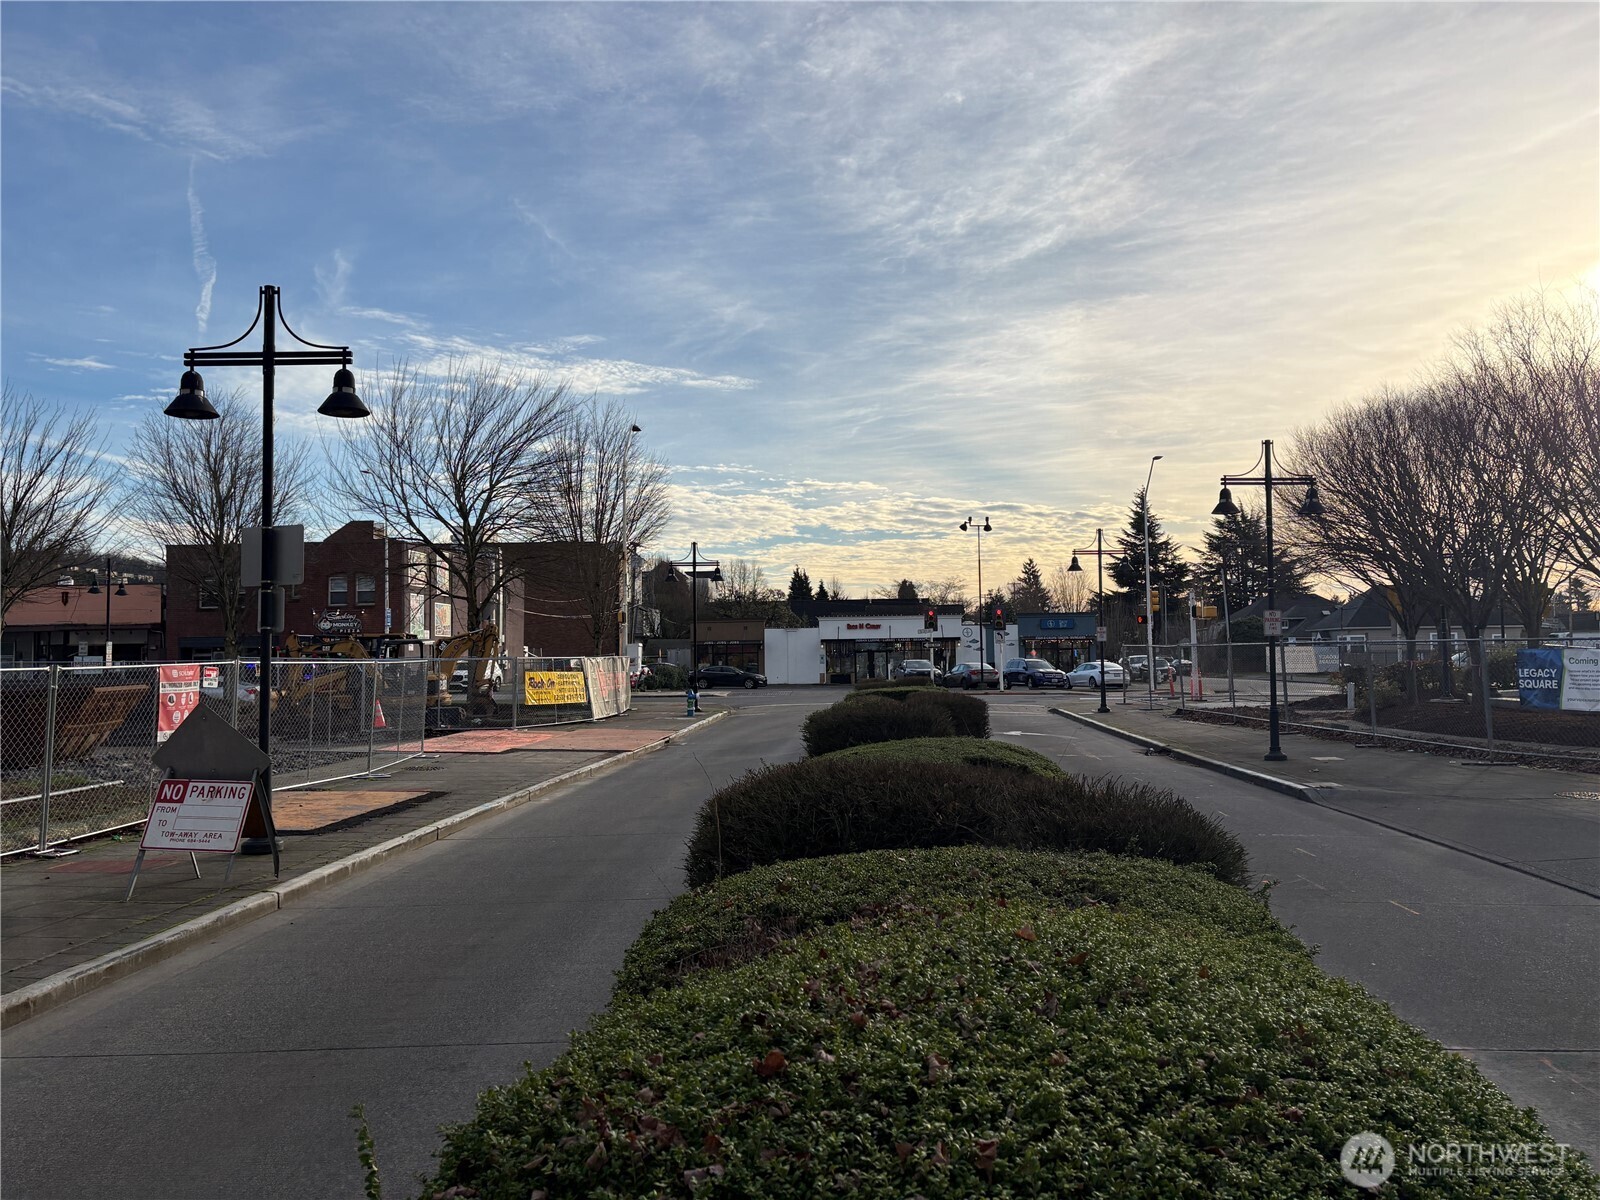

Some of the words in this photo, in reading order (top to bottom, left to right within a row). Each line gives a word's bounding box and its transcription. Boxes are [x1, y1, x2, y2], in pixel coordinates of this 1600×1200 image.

[326, 612, 357, 621] Smoking
[1568, 657, 1599, 666] Coming
[1518, 668, 1557, 678] LEGACY
[528, 676, 545, 689] Rock
[1519, 679, 1559, 689] SQUARE
[160, 784, 184, 800] NO
[189, 786, 247, 799] PARKING
[158, 819, 168, 827] TO
[160, 830, 199, 838] TOW-AWAY
